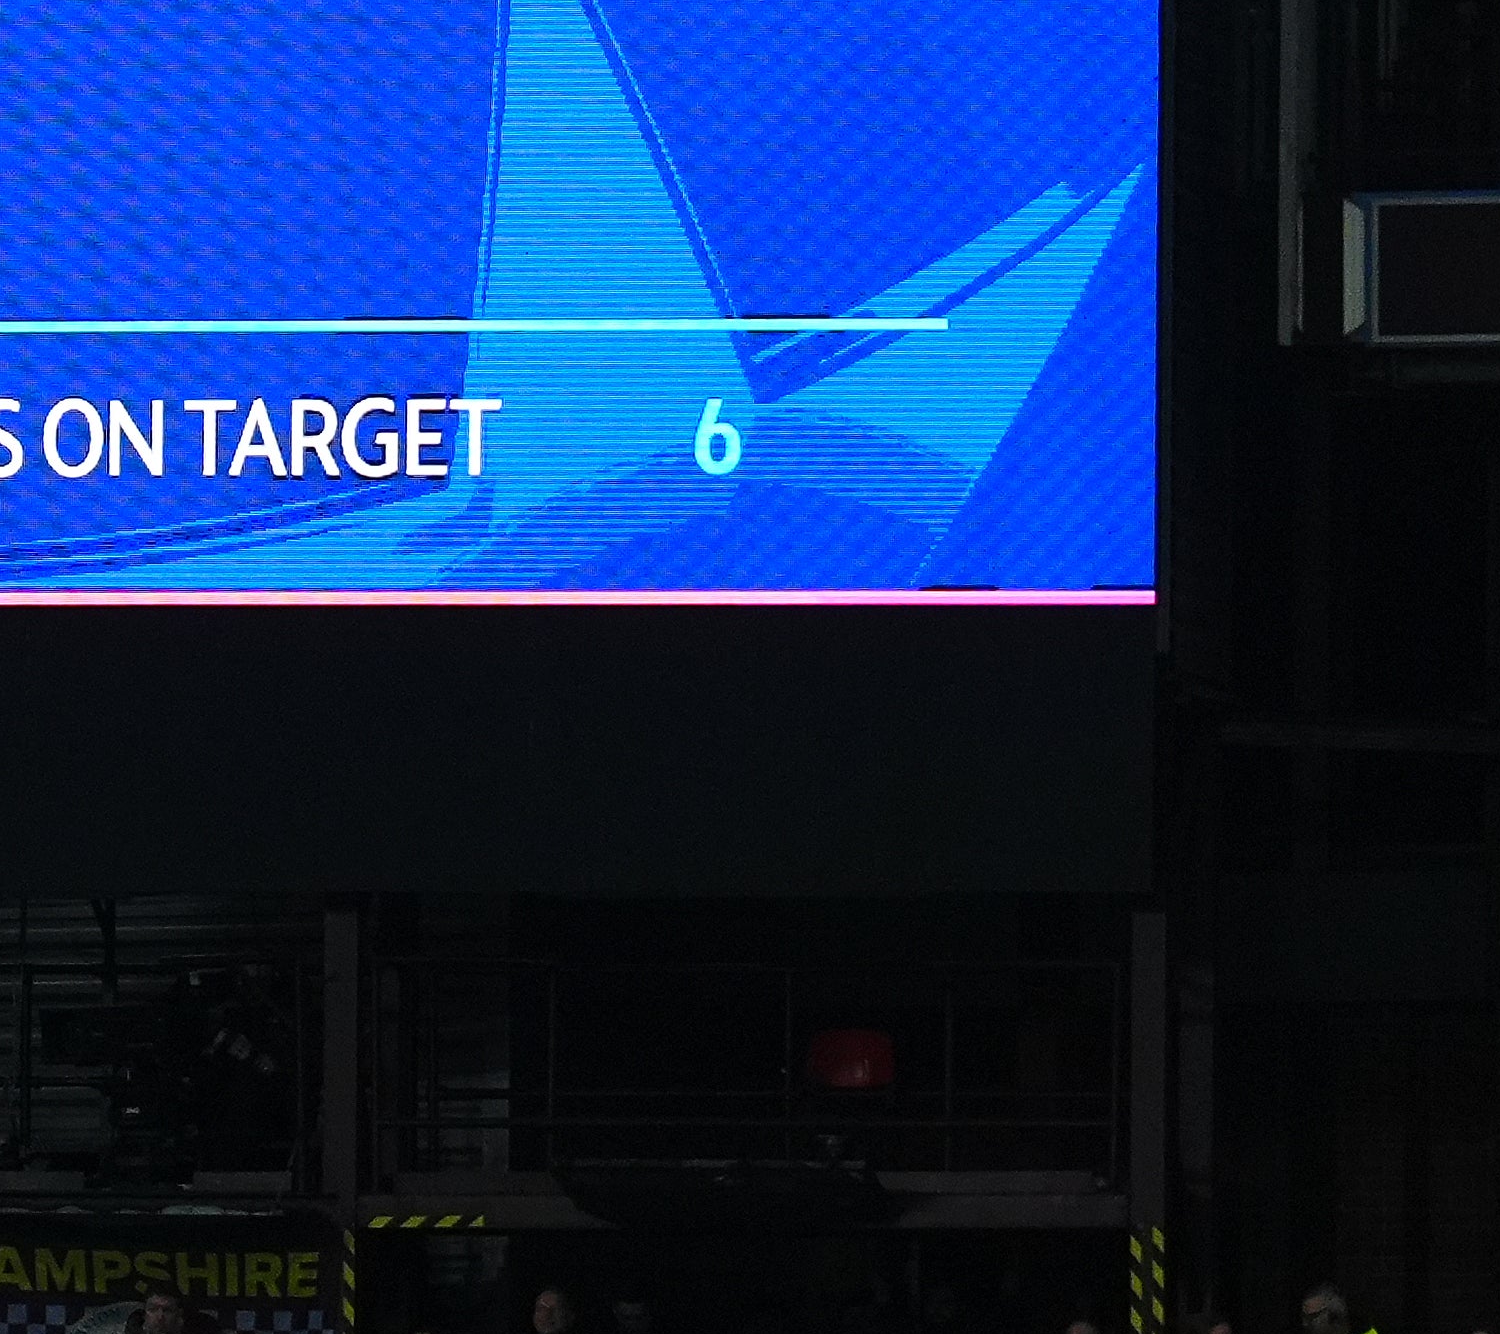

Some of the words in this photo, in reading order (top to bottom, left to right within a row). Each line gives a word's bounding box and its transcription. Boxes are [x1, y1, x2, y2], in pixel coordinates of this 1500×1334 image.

[42, 397, 164, 479] ON
[183, 397, 503, 479] TARGET
[694, 398, 741, 474] 6
